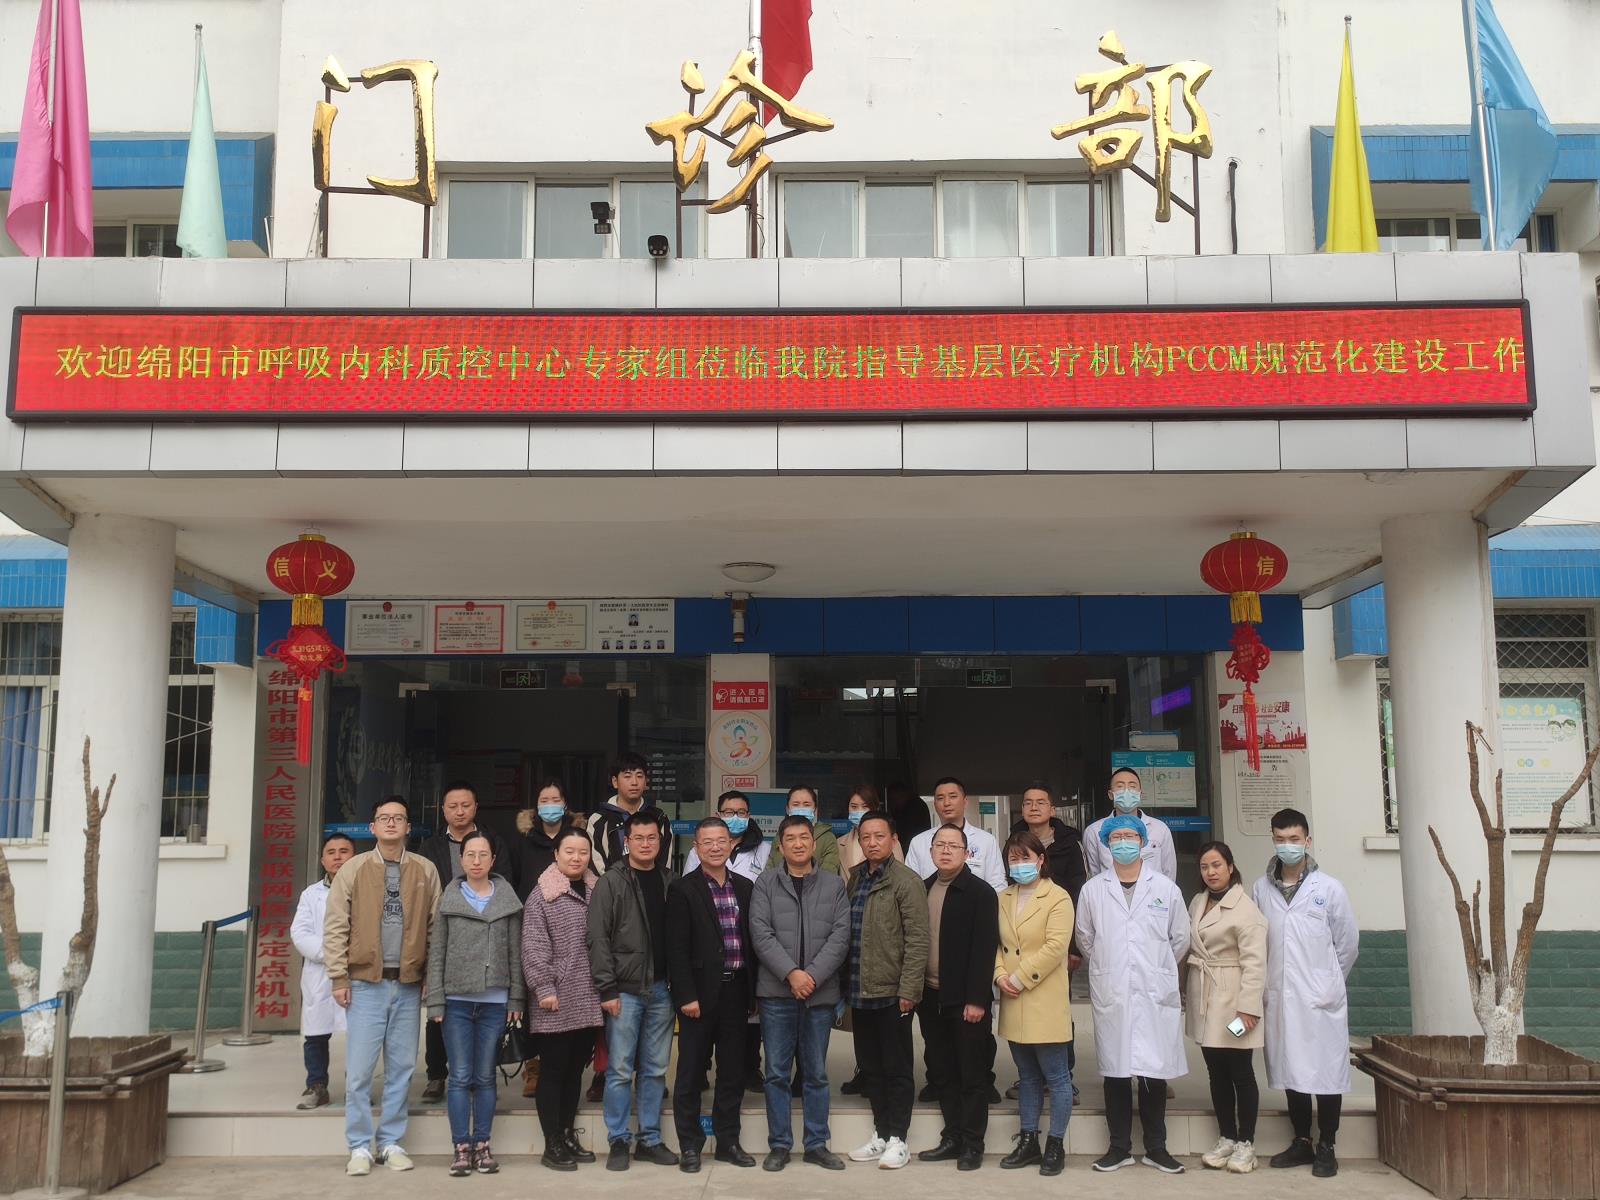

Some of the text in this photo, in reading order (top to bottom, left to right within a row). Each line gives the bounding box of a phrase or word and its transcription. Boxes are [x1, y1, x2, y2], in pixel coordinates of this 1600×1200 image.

[313, 29, 1212, 223] 门诊部
[55, 336, 1525, 382] 欢迎绵阳市呼吸内科质控中心专家组莅临我院指导基层医疗机构PCCM规范化建设工作
[1256, 556, 1275, 577] 信
[729, 688, 766, 696] 进入医院
[254, 670, 301, 1019] 绵阳市第三人民医院互联网医疗定点机构
